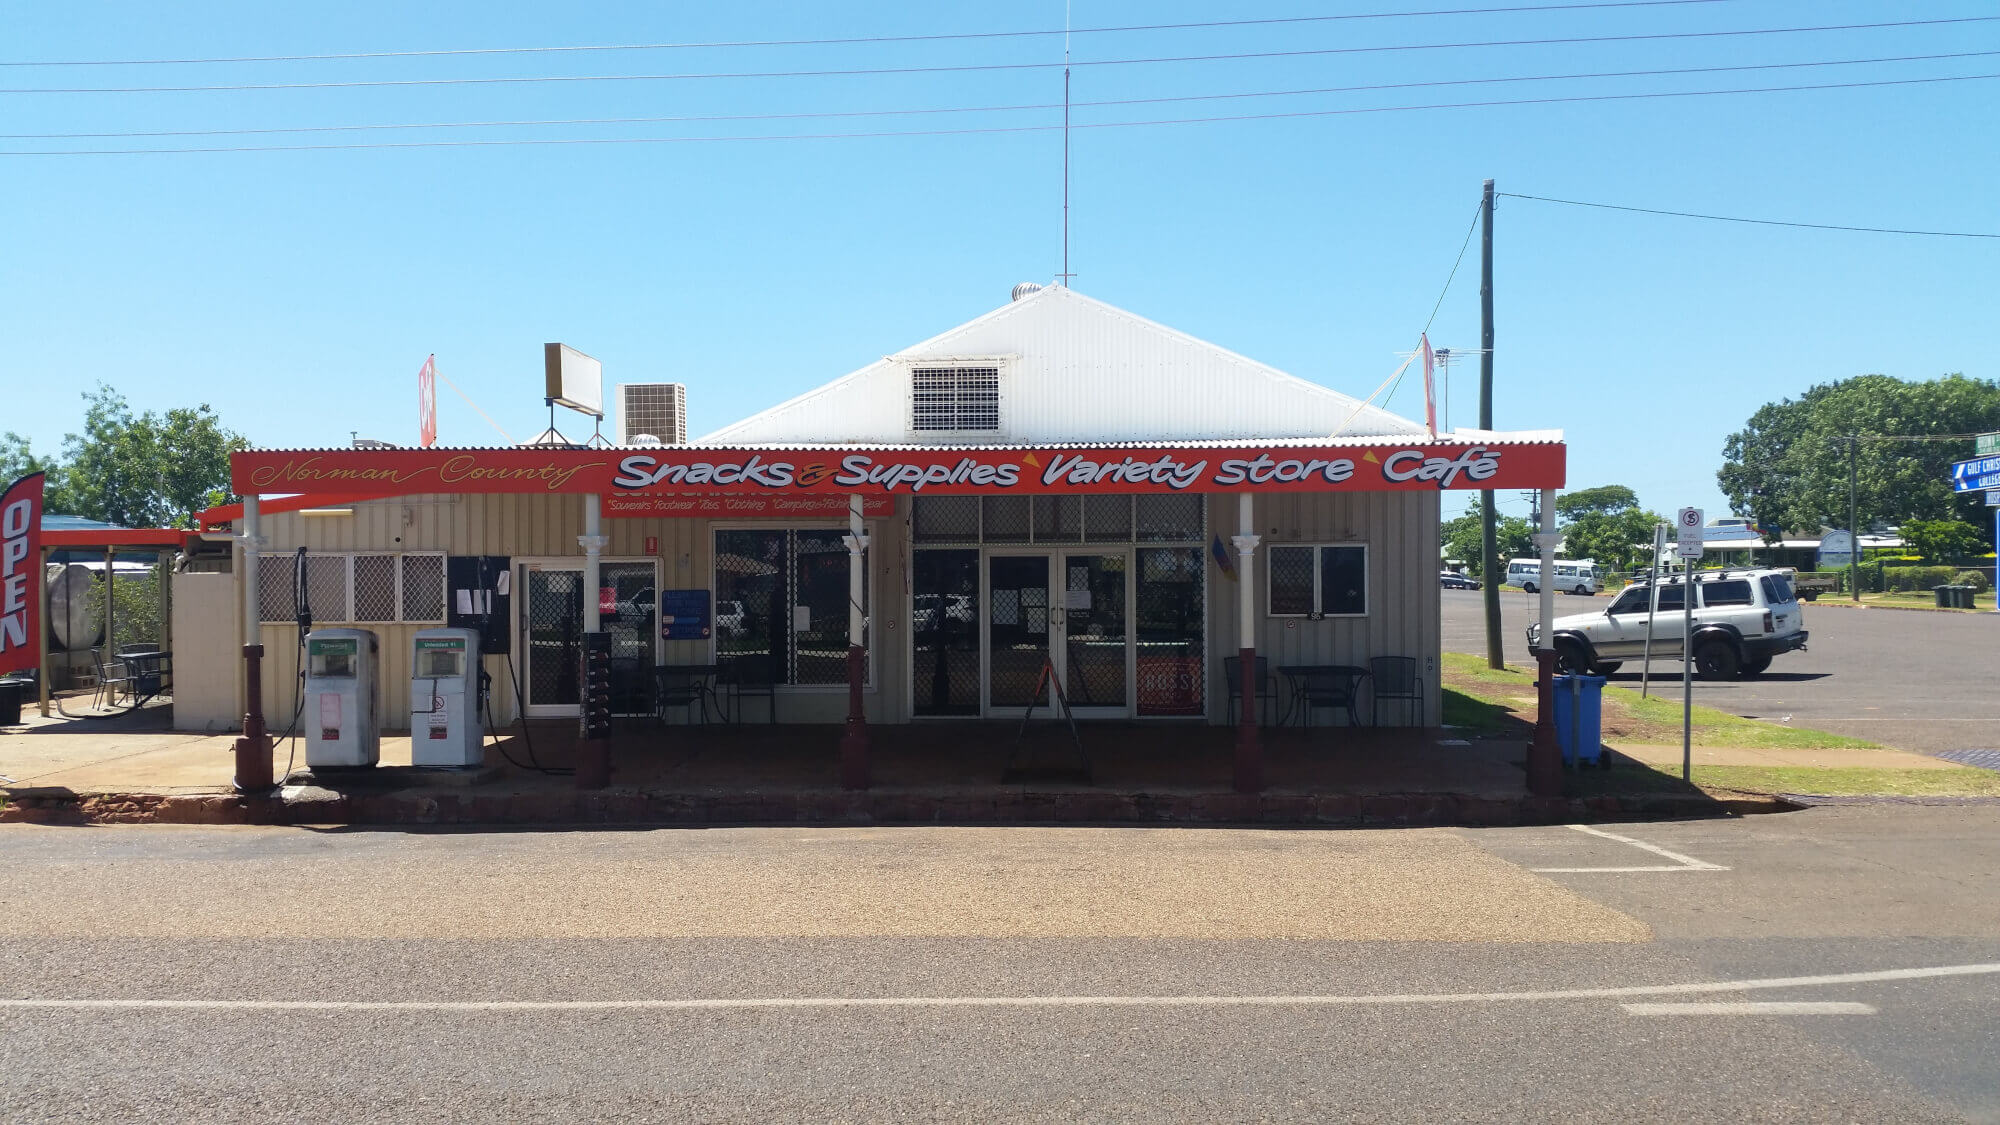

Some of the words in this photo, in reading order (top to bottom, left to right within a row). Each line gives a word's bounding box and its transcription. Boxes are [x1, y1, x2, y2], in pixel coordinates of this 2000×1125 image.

[251, 456, 437, 487] Norman
[440, 455, 607, 490] County
[612, 454, 795, 488] Snacks
[797, 462, 839, 487] &
[834, 455, 1020, 491] Supplies
[1040, 453, 1207, 489] Variety
[1967, 461, 1981, 475] GULF
[0, 498, 32, 651] OPEN
